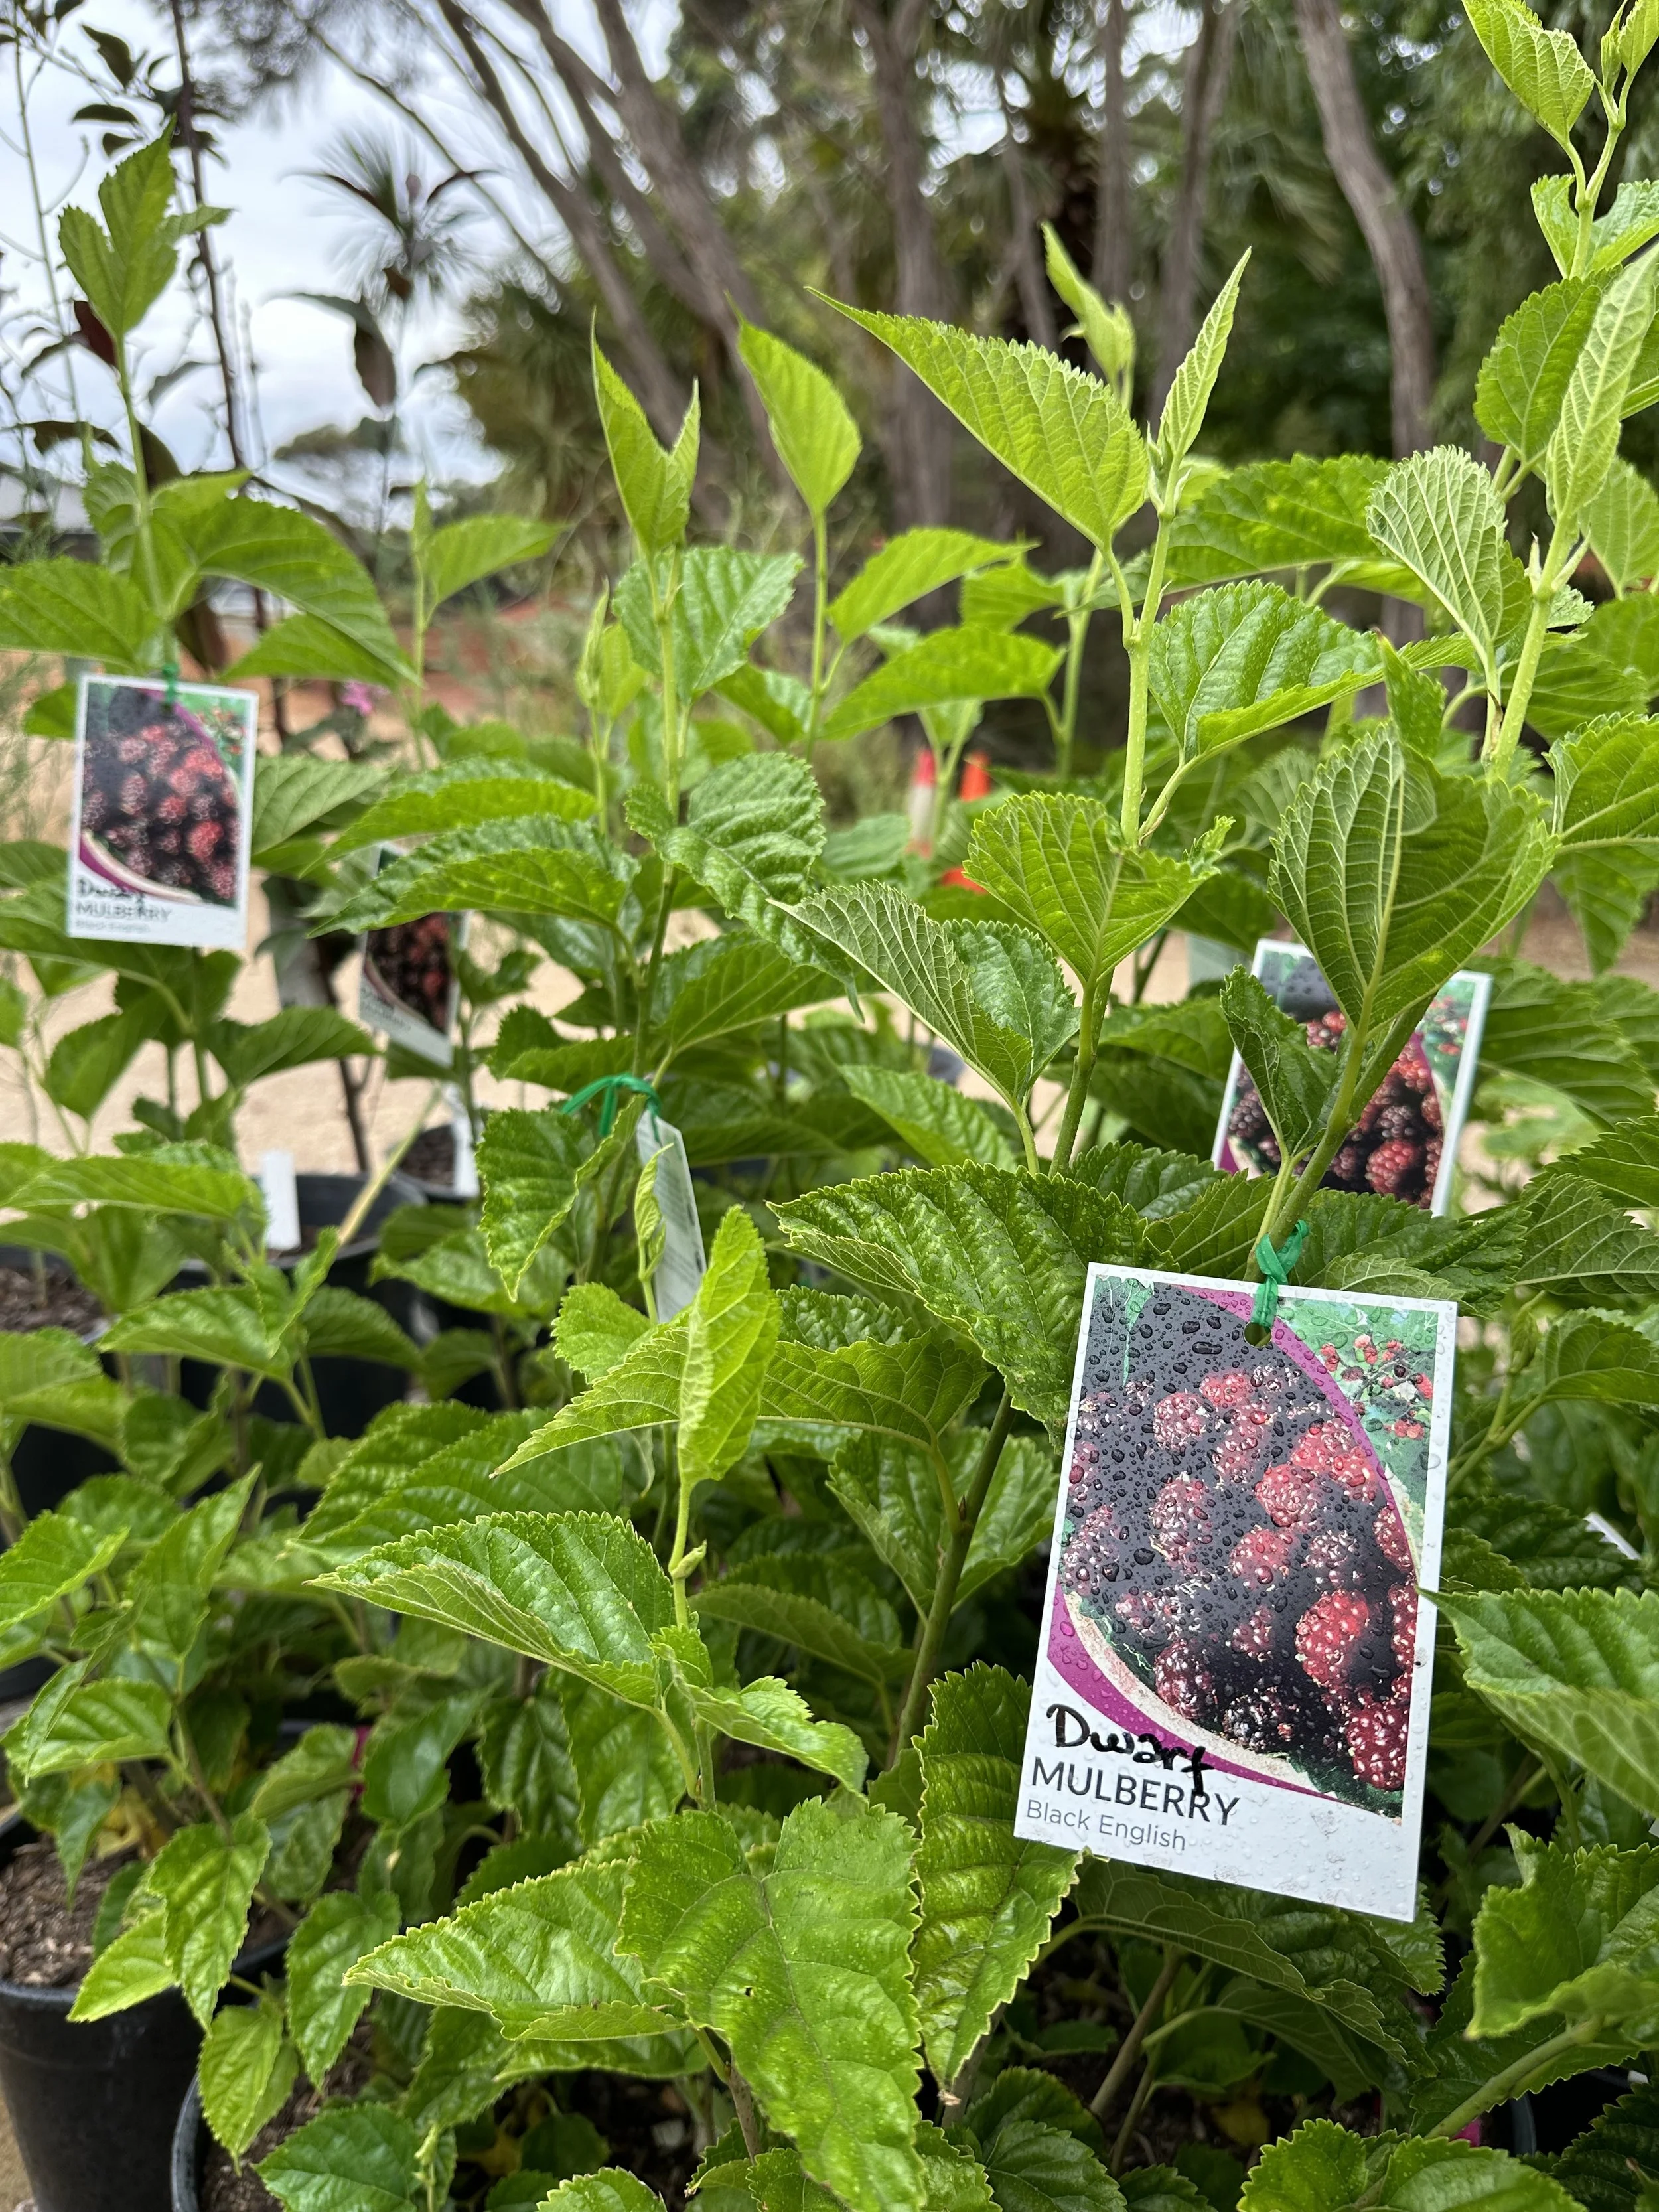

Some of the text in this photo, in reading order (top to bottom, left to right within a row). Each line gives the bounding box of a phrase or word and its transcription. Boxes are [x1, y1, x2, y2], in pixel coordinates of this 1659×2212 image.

[76, 902, 173, 922] MULBERRY
[1046, 1704, 1214, 1795] Dwarf
[1033, 1757, 1240, 1825] MULBERRY
[1027, 1800, 1185, 1850] Black English
